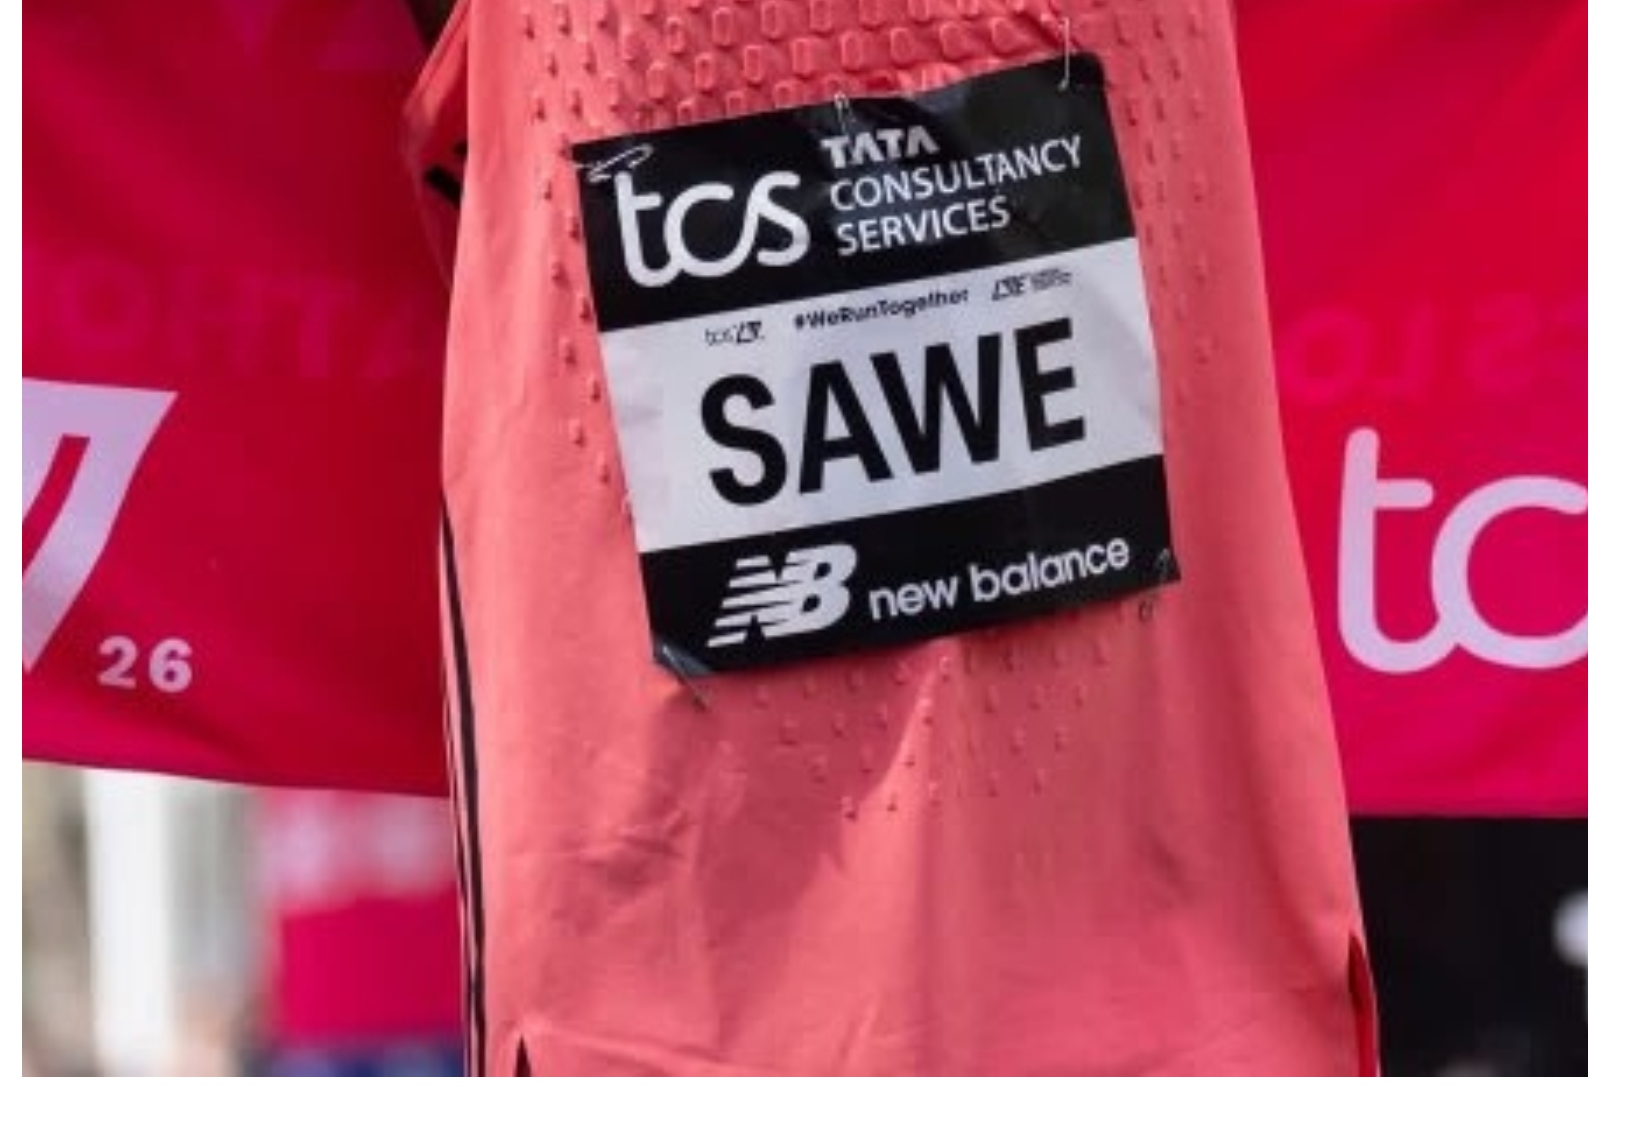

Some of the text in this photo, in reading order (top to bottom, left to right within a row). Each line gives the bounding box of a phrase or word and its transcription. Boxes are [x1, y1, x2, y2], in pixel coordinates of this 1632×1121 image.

[821, 125, 939, 170] TATA
[830, 136, 1082, 212] CONSULTANCY
[614, 170, 811, 289] tcs
[836, 195, 1011, 257] SERVICES
[793, 286, 969, 331] #WeRunTogether
[700, 318, 1086, 507] SAWE
[870, 536, 1132, 622] new balance
[98, 635, 194, 694] 26
